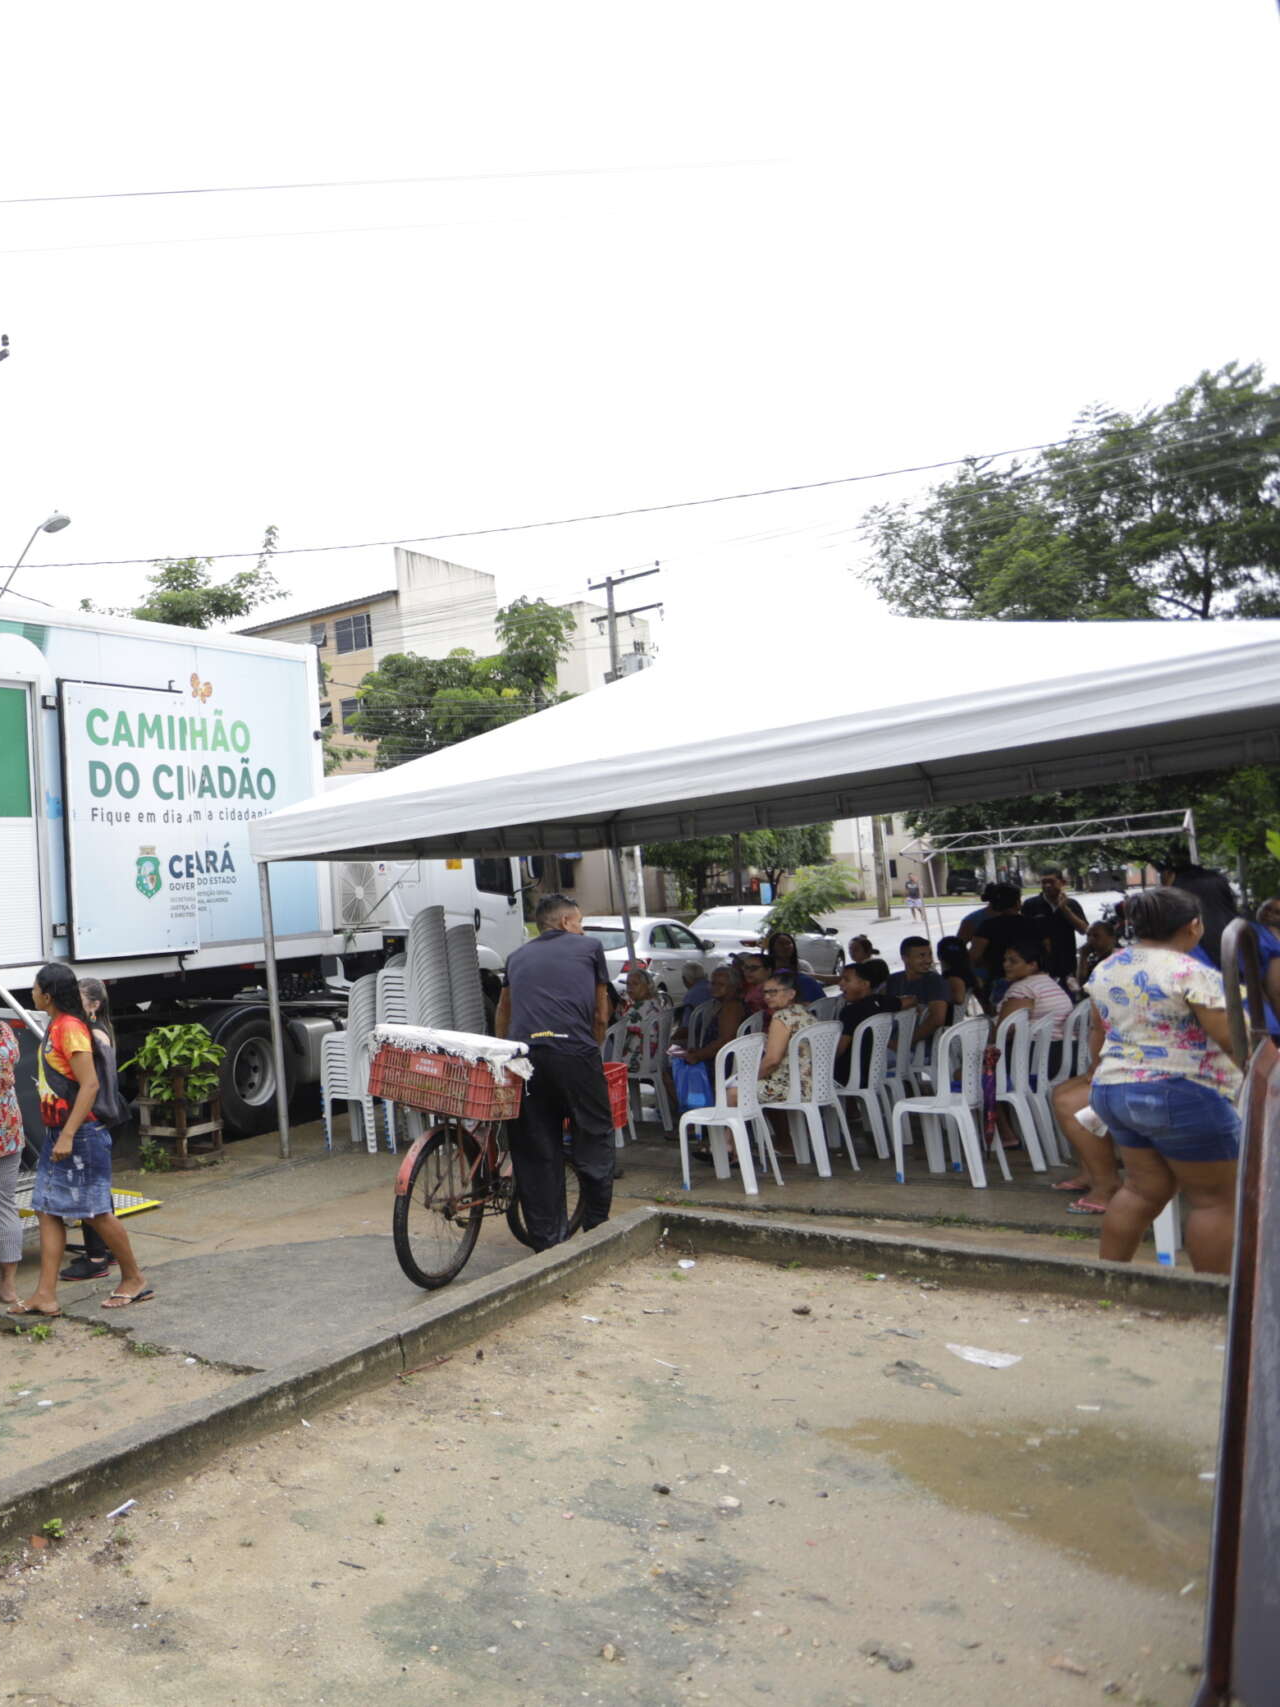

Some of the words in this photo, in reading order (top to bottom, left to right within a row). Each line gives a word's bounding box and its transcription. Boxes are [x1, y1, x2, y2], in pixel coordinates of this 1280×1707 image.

[88, 760, 140, 799] DO
[91, 807, 131, 826] Fique
[138, 811, 156, 823] em
[163, 809, 183, 824] dia
[209, 875, 237, 885] ESTADO
